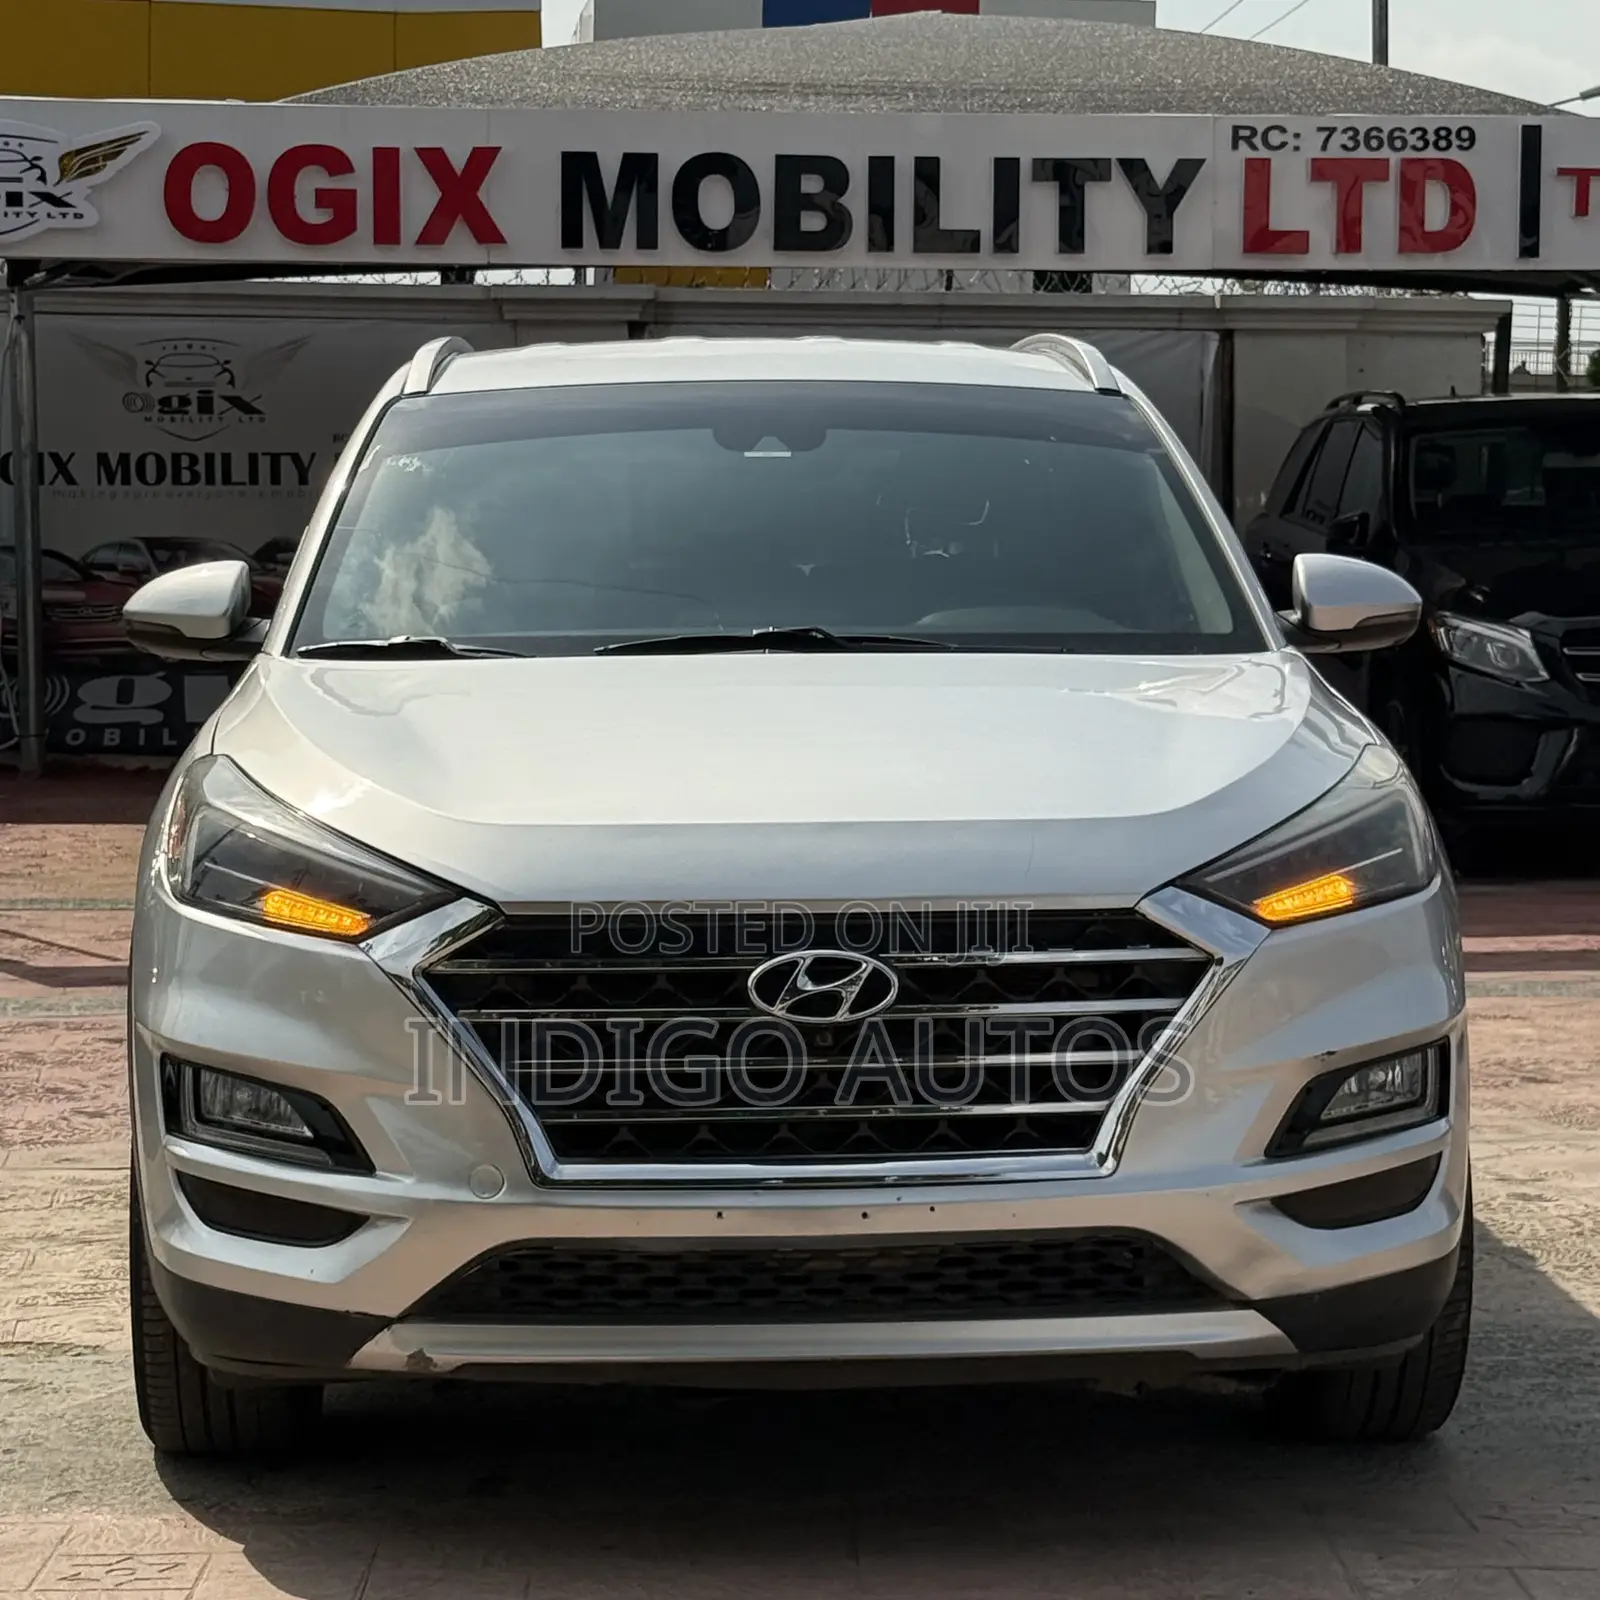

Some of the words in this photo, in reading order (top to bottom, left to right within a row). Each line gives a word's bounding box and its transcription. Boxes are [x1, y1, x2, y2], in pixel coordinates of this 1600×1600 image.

[1230, 125, 1302, 152] RC:
[1315, 125, 1477, 153] 7366389
[163, 141, 508, 246] OGIX
[560, 151, 1207, 256] MOBILITY
[1242, 157, 1477, 255] LTD
[46, 211, 85, 220] LTD
[97, 451, 316, 486] MOBILITY
